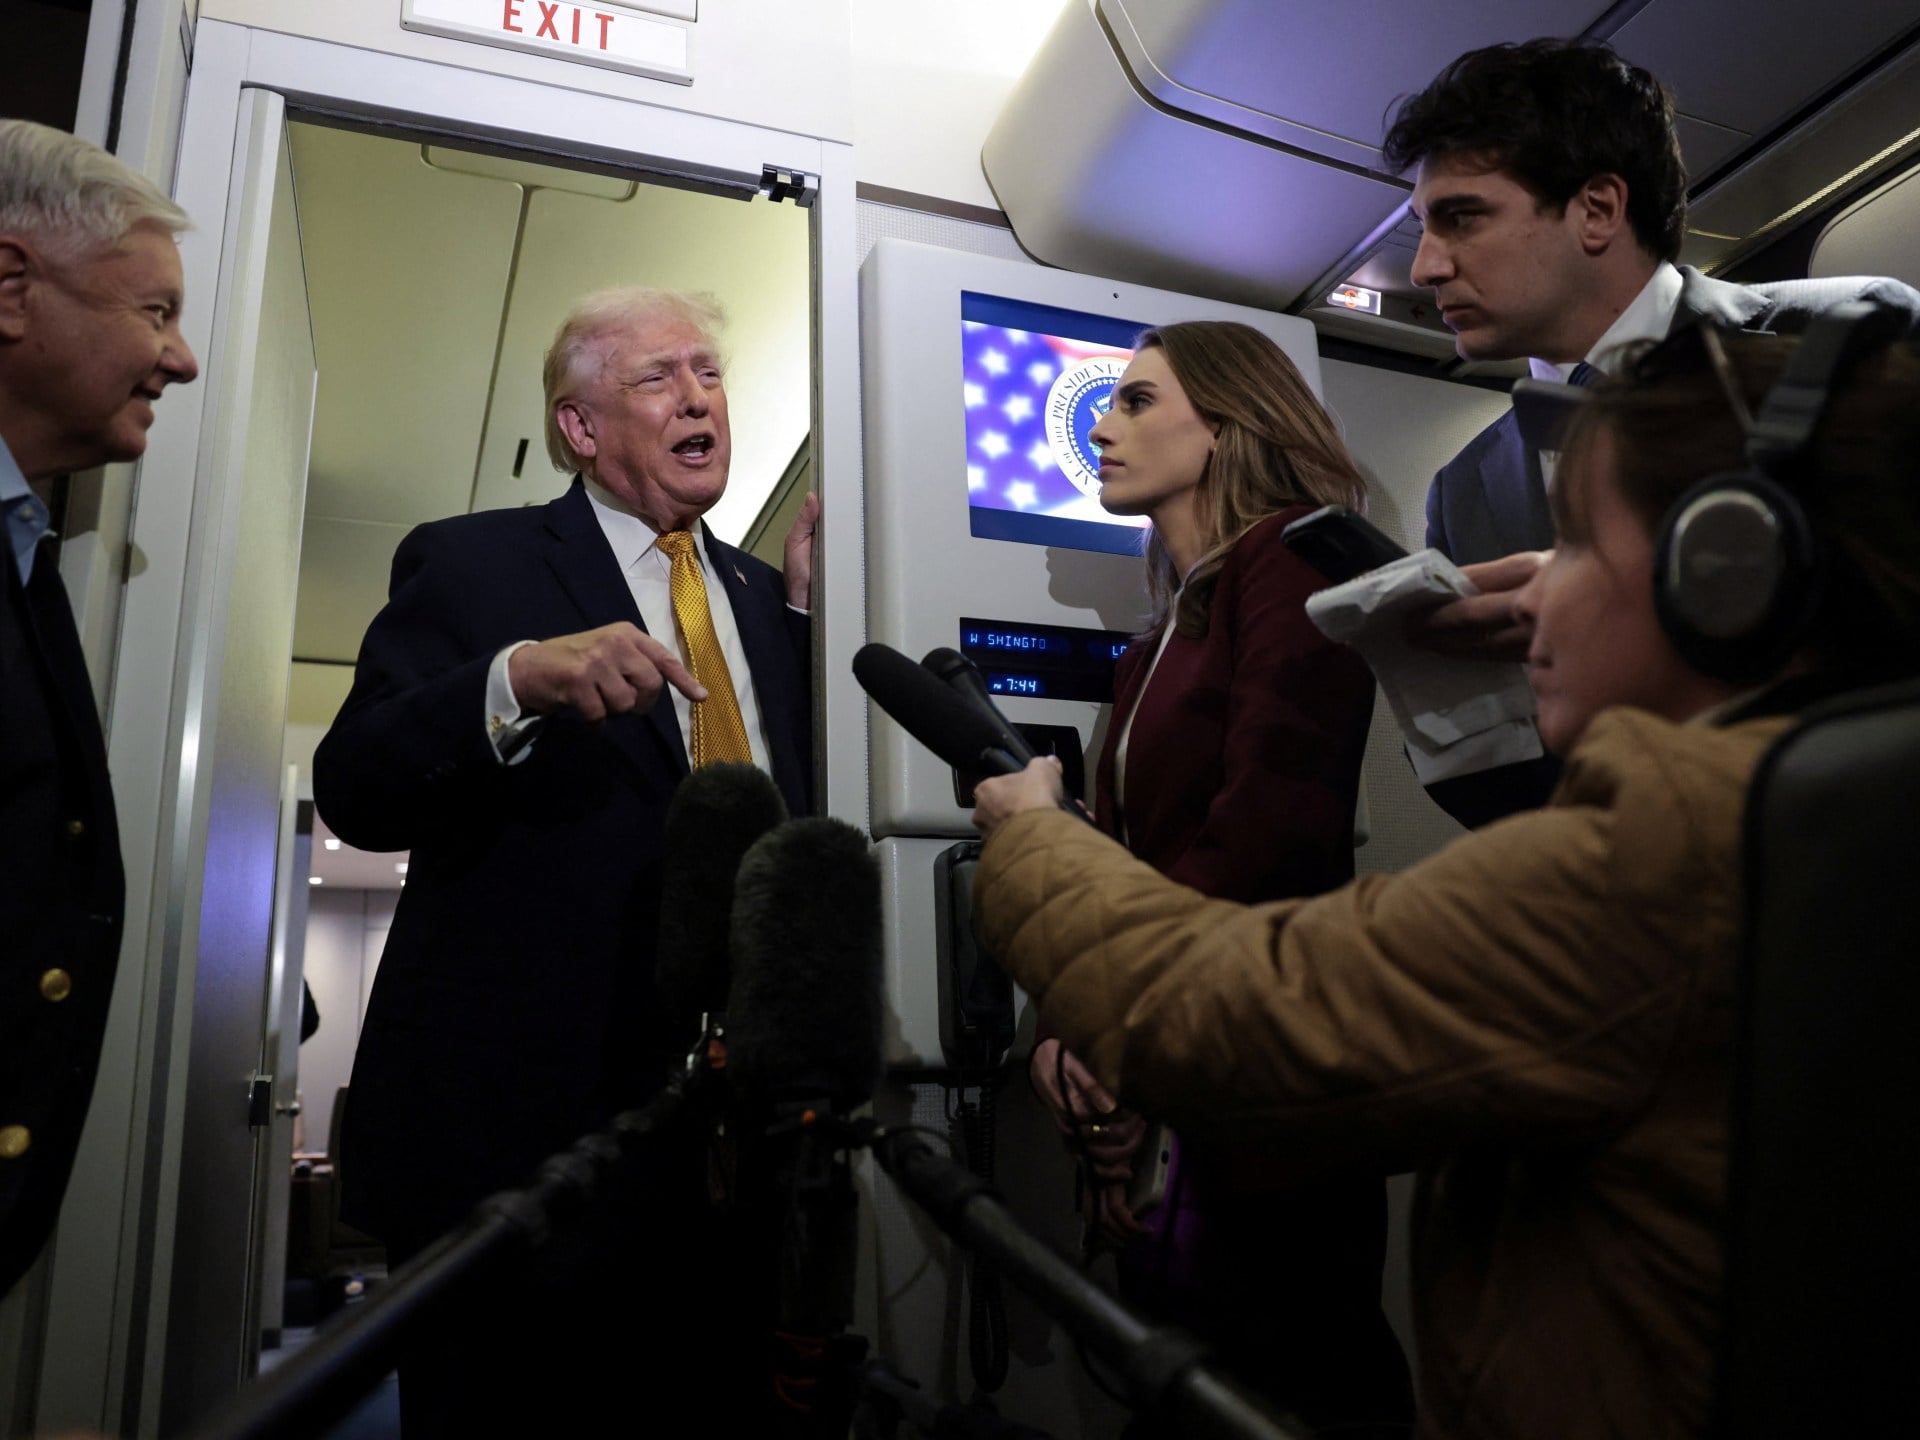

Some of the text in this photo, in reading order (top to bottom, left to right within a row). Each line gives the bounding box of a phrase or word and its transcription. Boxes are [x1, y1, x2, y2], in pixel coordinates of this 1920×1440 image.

[503, 0, 615, 50] EXIT
[1052, 363, 1112, 420] PRESIDENT
[1006, 678, 1037, 692] 7:44
